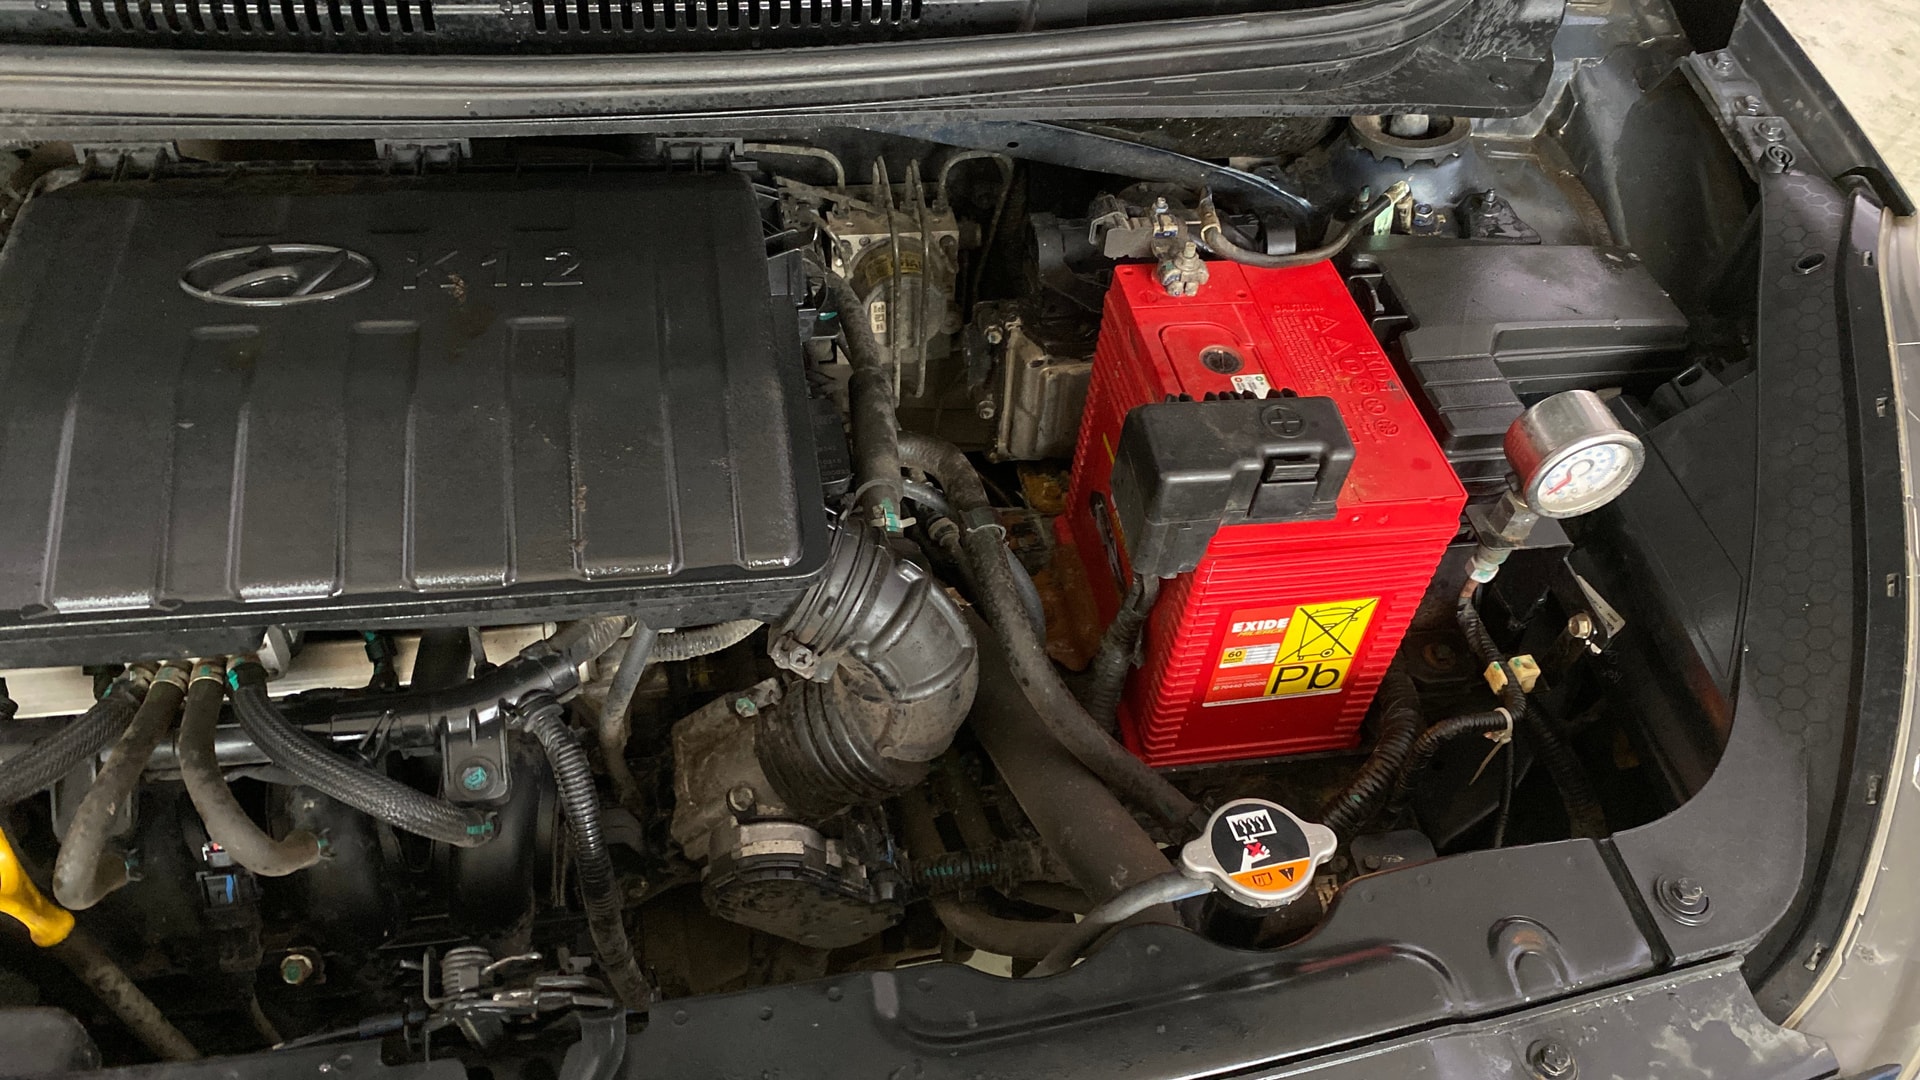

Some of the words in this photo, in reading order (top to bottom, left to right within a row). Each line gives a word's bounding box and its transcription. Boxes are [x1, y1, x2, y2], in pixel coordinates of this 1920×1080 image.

[1231, 617, 1290, 633] EXIDE
[1227, 650, 1242, 658] 60
[1271, 663, 1341, 694] Pb
